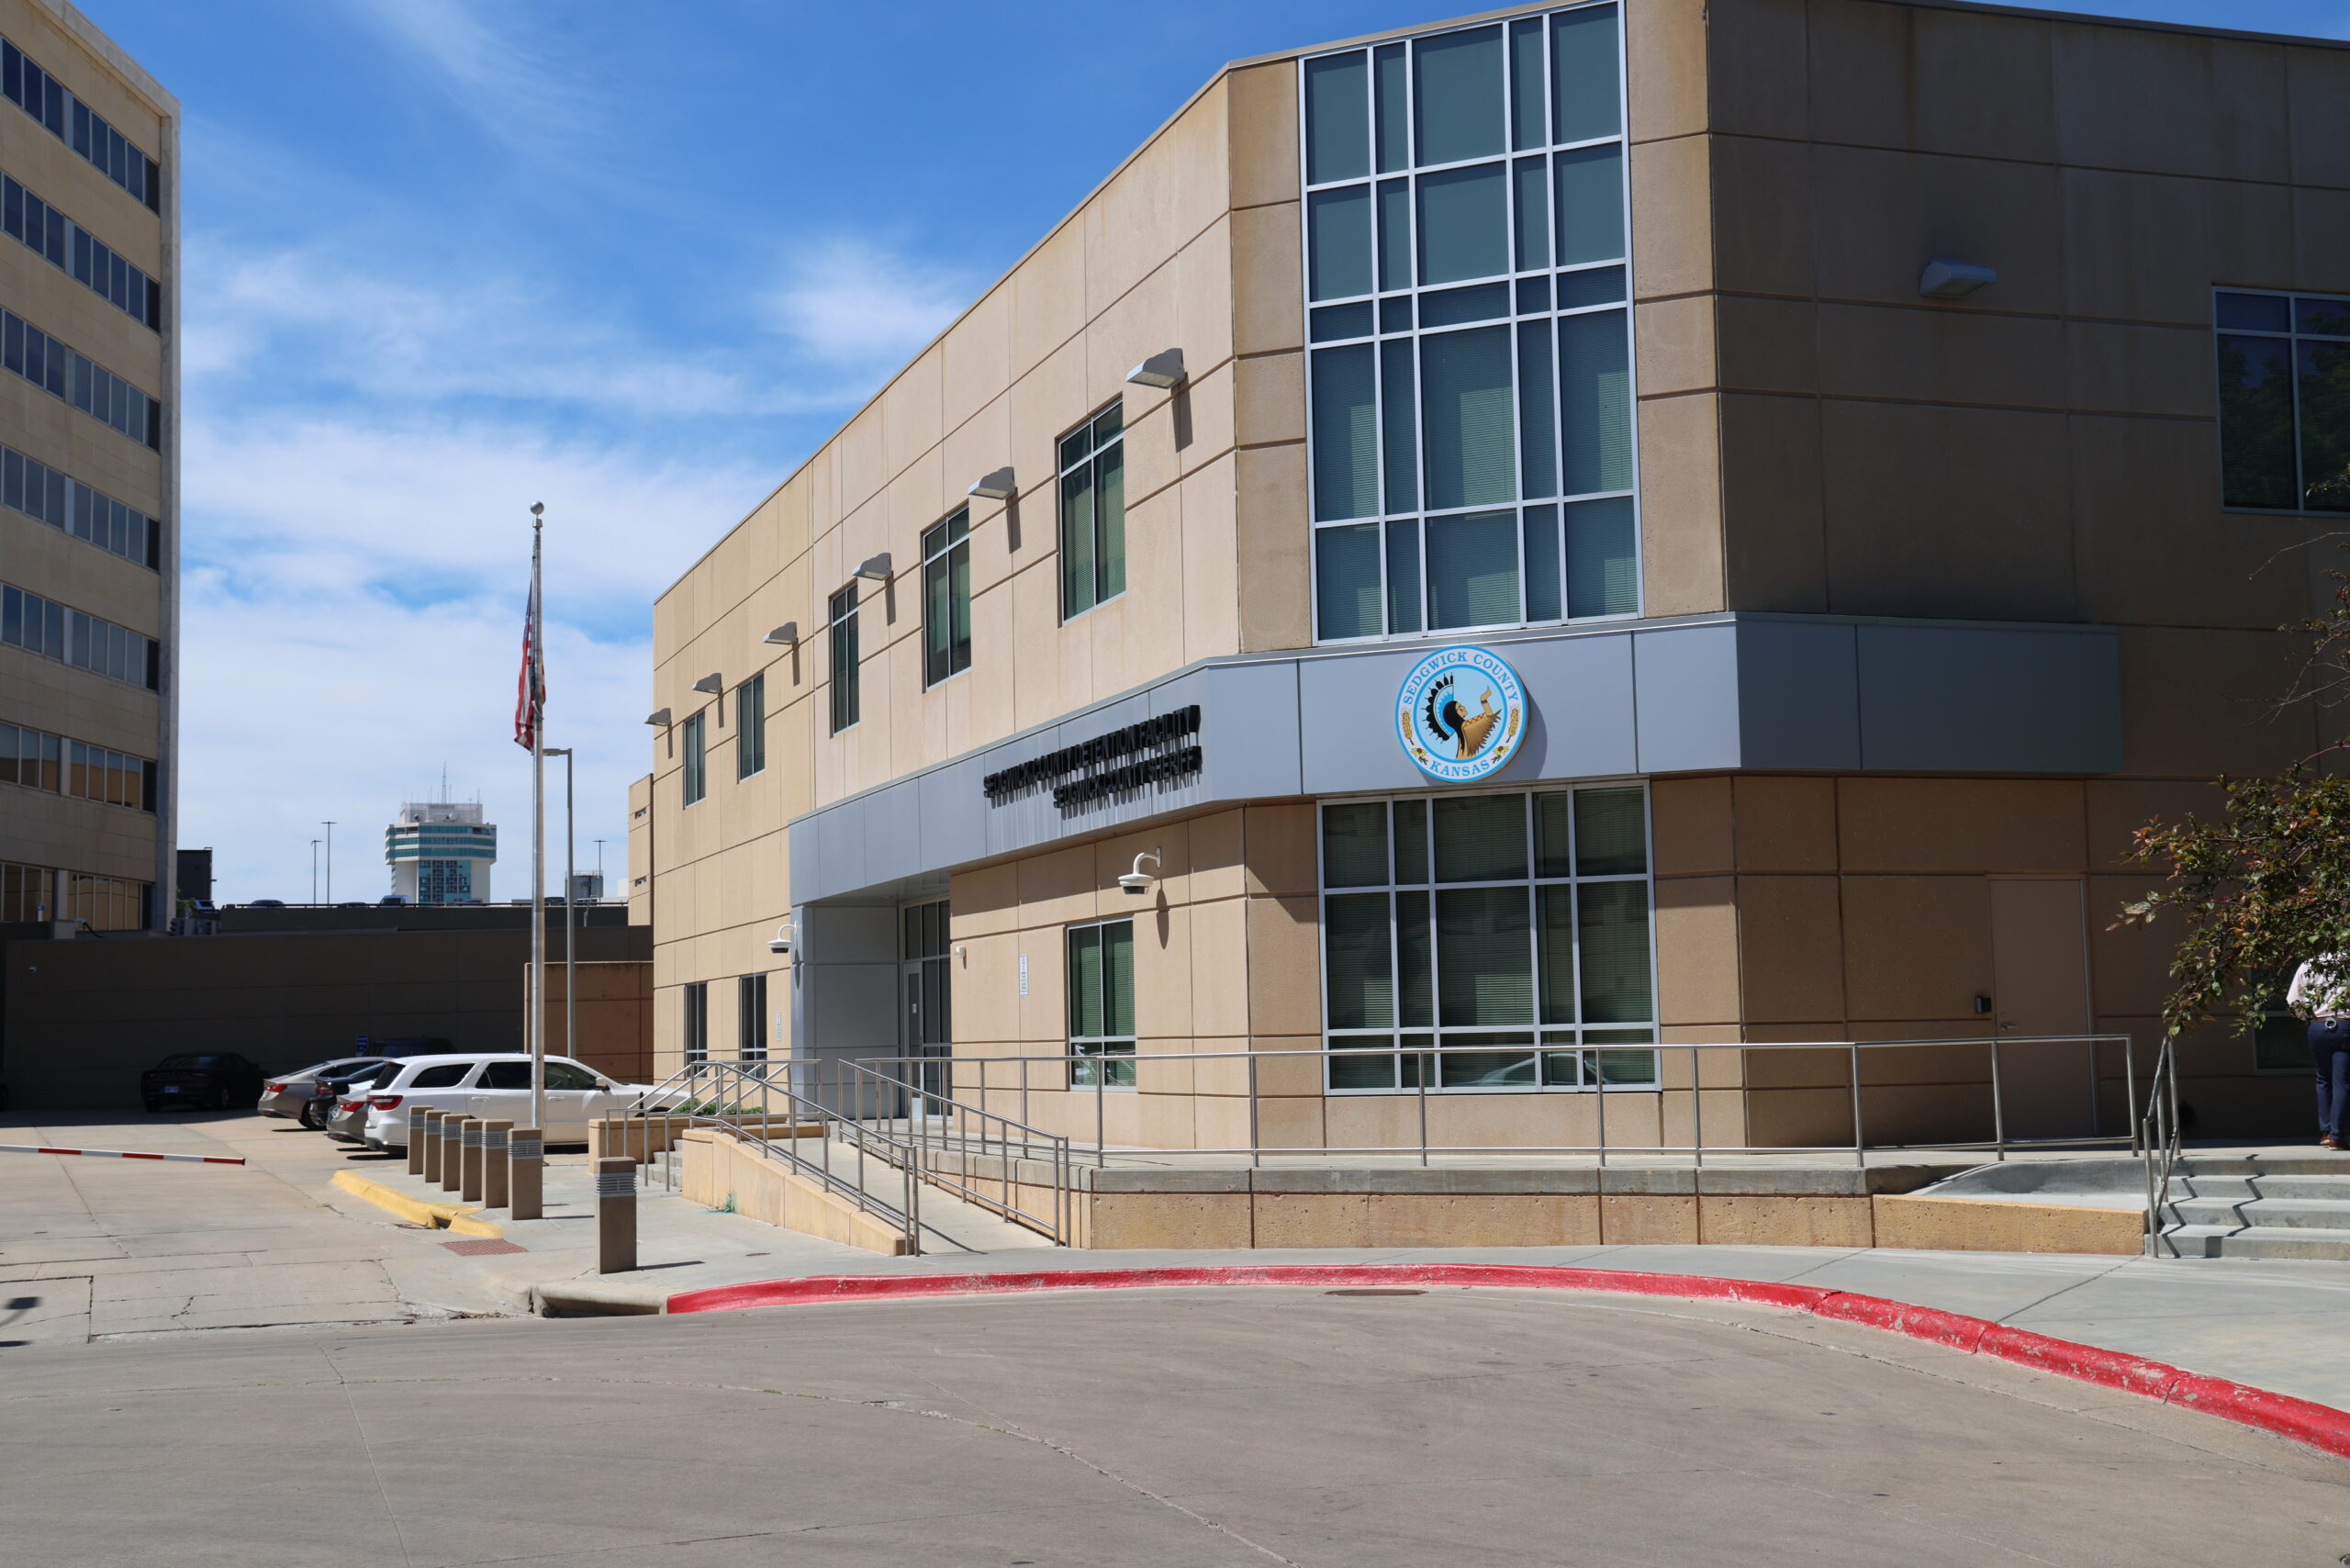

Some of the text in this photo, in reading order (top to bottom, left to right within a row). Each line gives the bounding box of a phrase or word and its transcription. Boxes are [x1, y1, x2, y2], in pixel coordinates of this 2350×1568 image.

[1403, 651, 1518, 705] SEDGWICK COUNTY
[983, 705, 1201, 798] SEDGWICK COUNTY DETENTION FACILITY
[1053, 746, 1201, 808] SEDGWICK COUNTY SHERIFF
[1429, 759, 1490, 777] KANSAS
